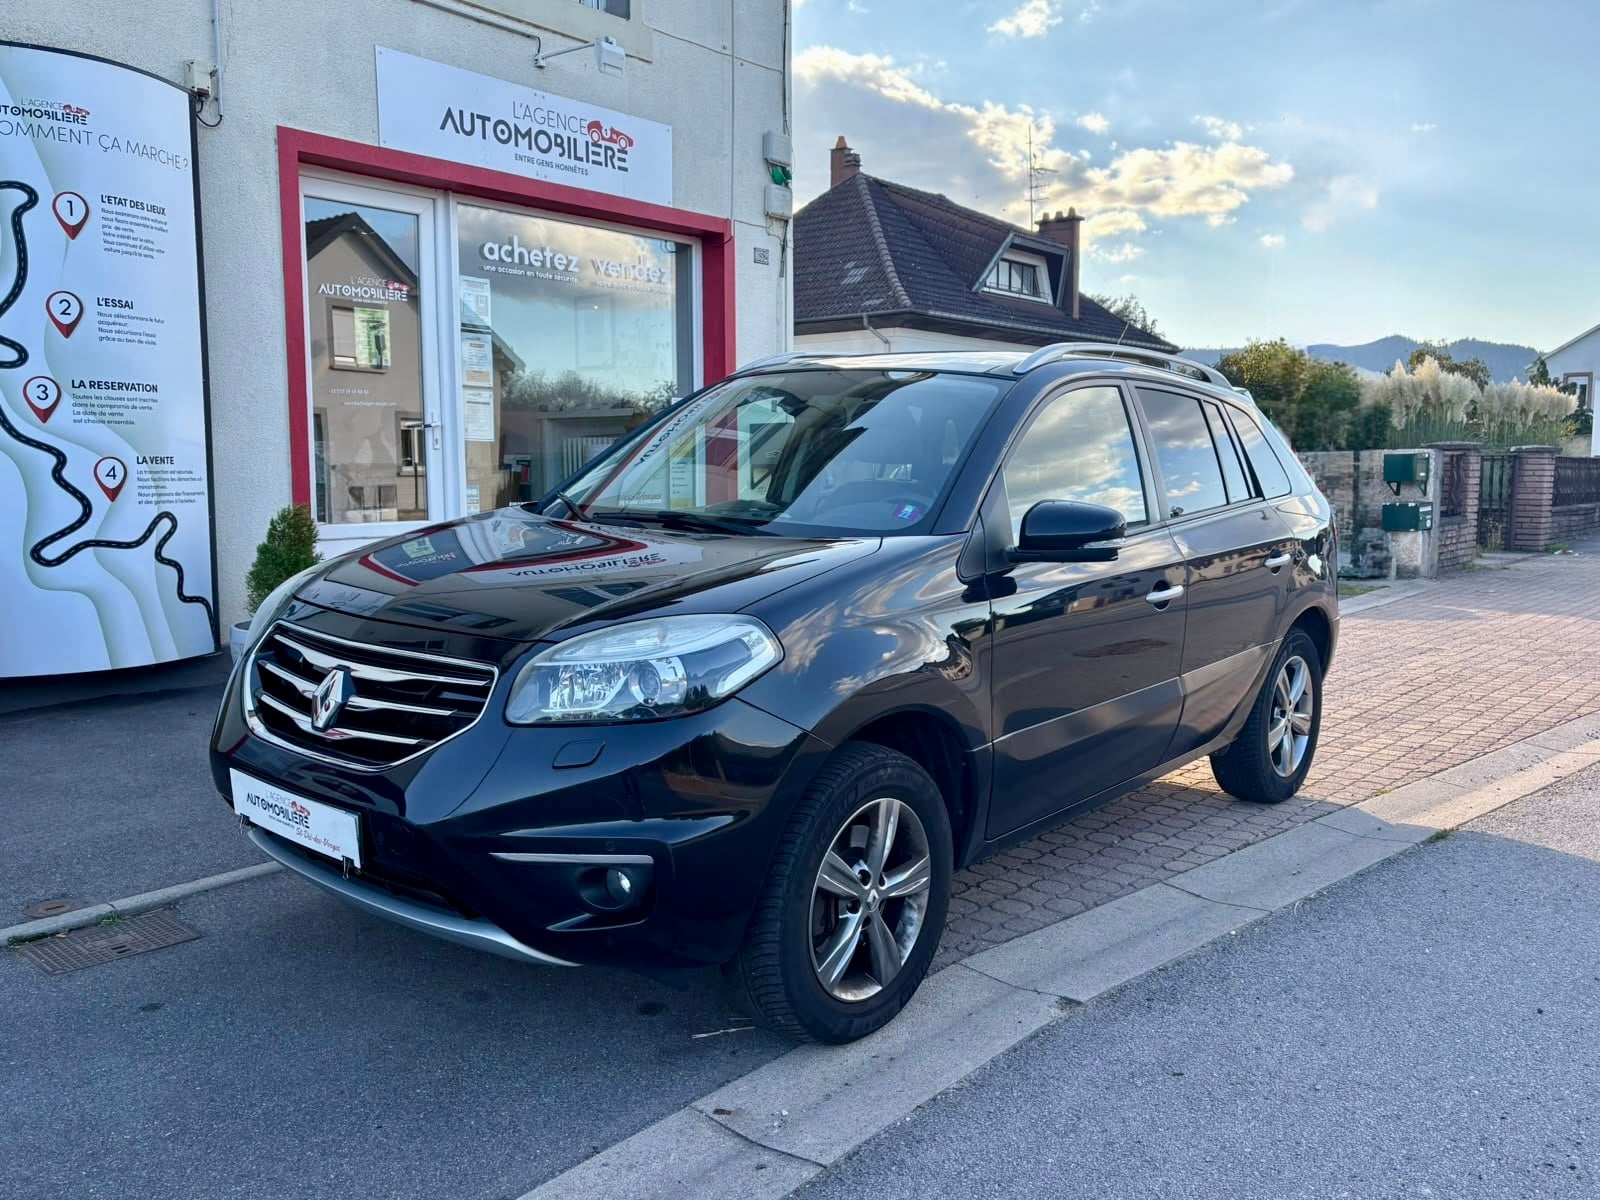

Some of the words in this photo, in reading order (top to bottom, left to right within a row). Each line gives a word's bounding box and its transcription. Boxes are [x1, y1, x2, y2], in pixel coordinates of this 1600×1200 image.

[21, 98, 64, 110] L'AGENCE
[0, 104, 87, 125] TOMOBILIERE
[512, 101, 588, 136] L'AGENCE
[0, 120, 93, 146] OMMENT
[98, 134, 122, 153] ÇA
[514, 153, 535, 165] ENTRE
[536, 158, 554, 169] GENS
[554, 160, 589, 176] HONNÊTES
[66, 200, 74, 217] 1
[101, 194, 128, 207] L'ETAT
[129, 200, 145, 211] DES
[146, 203, 167, 216] LIEUX
[482, 235, 579, 273] achetez
[483, 264, 496, 272] une
[497, 266, 526, 275] occasion
[526, 269, 535, 277] en
[535, 271, 553, 280] toute
[553, 273, 578, 283] sécurité
[595, 255, 671, 284] vendez
[351, 275, 387, 287] L'AGENCE
[59, 299, 71, 315] 2
[96, 297, 134, 310] L'ESSAI
[97, 311, 113, 319] Nous
[36, 384, 49, 401] 3
[71, 379, 87, 389] LA
[88, 380, 158, 393] RESERVATION
[136, 456, 148, 465] LA
[148, 456, 175, 465] VENTE
[105, 464, 117, 480] 4
